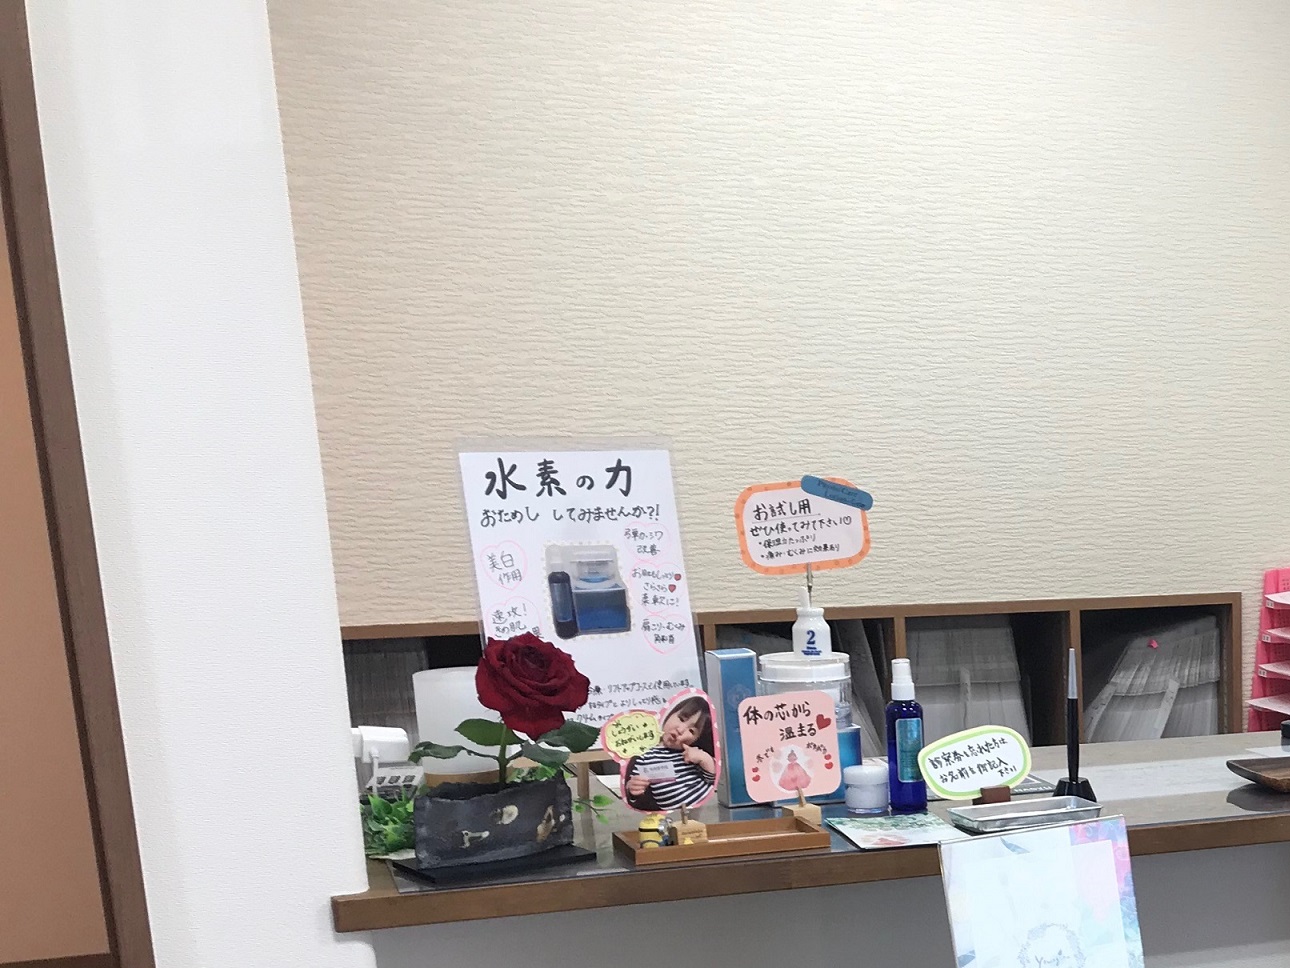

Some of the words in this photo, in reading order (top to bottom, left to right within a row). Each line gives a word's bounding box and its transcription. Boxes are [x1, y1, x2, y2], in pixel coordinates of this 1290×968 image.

[753, 498, 812, 521] お試し用
[487, 552, 514, 571] 美白
[806, 630, 816, 644] 2
[742, 701, 811, 725] 体の芯から
[779, 722, 817, 742] 温まる
